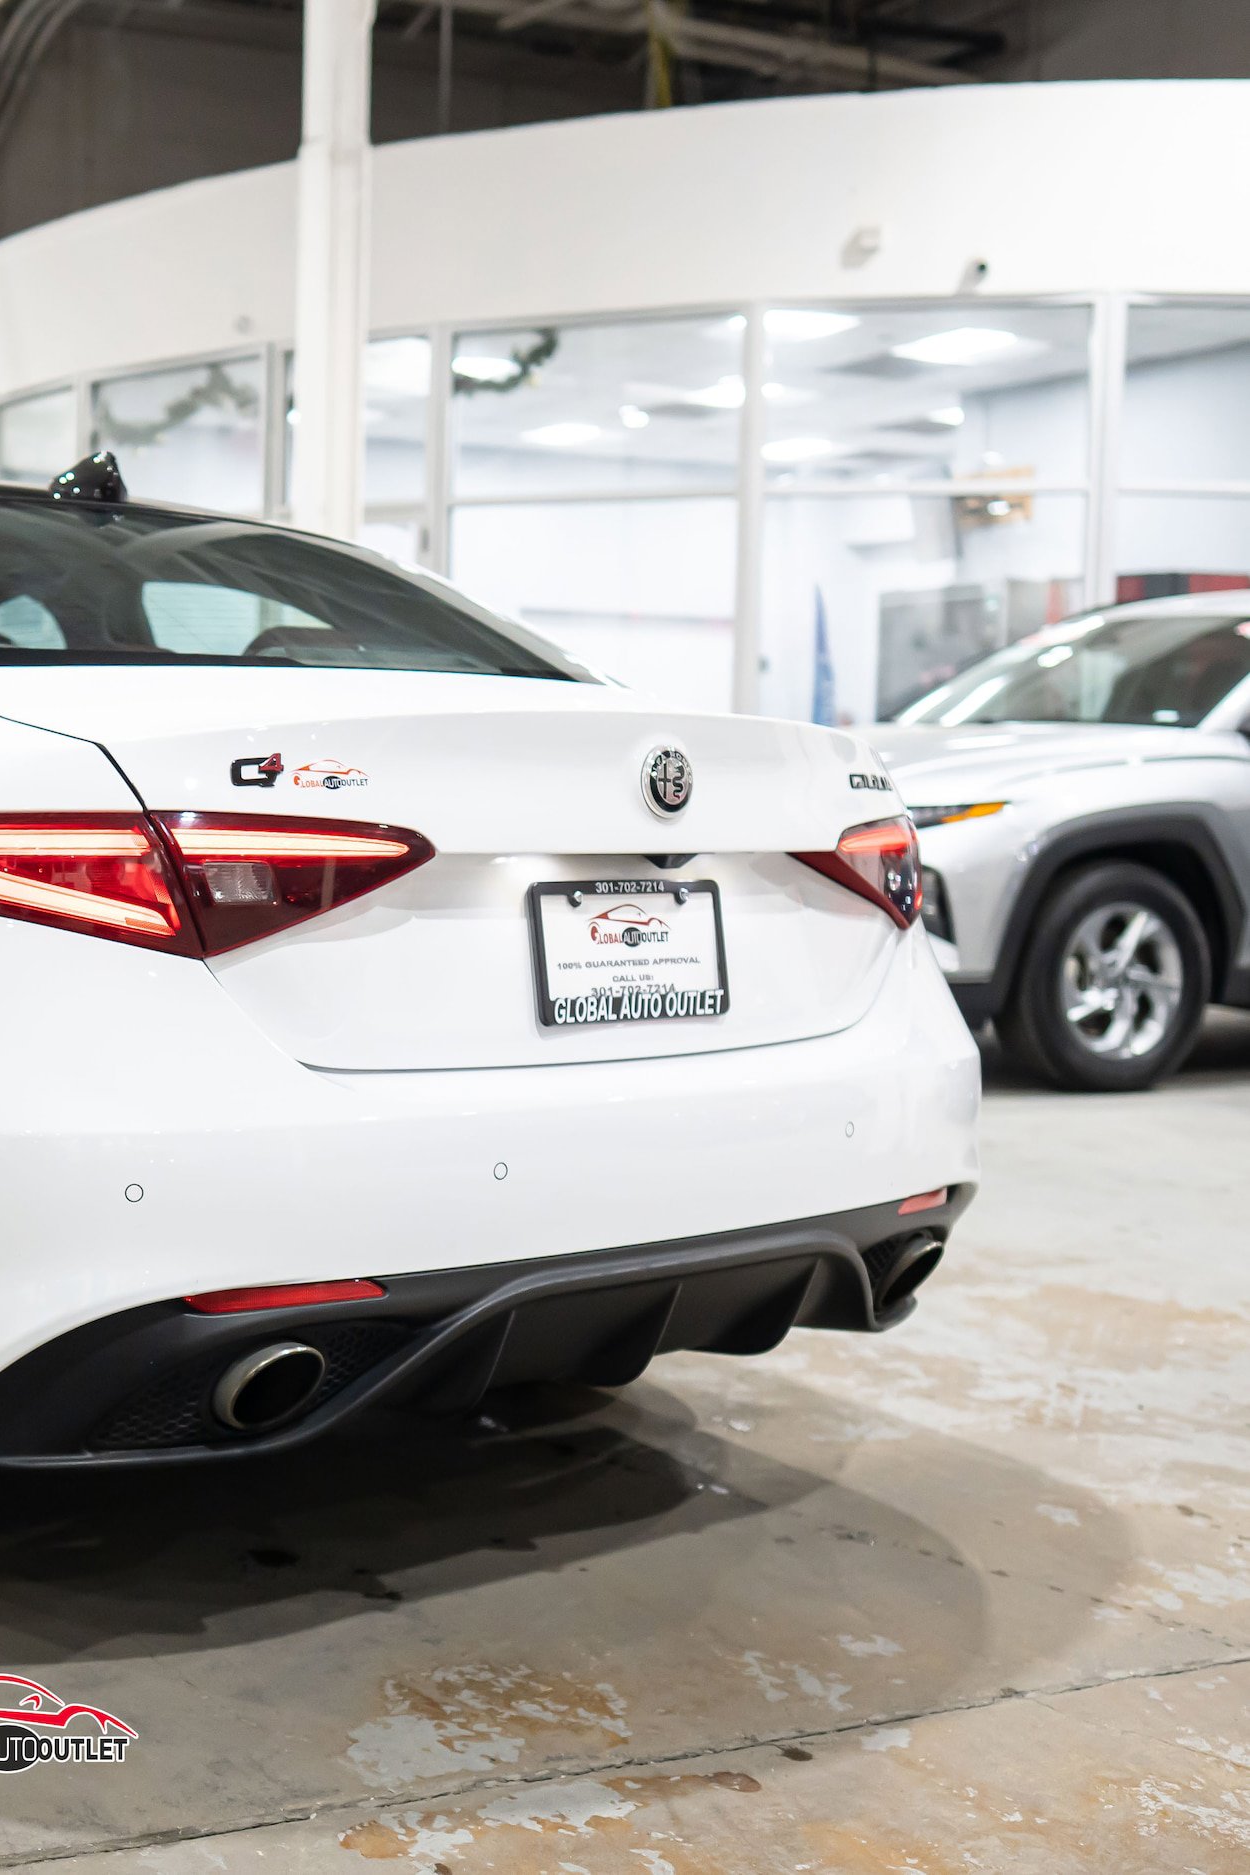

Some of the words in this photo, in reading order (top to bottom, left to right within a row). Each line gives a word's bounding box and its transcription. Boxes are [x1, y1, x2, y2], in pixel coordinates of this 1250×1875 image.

[230, 752, 284, 787] Q4
[595, 881, 664, 894] 301-702-7214
[557, 962, 582, 970] 100%
[585, 959, 650, 969] GUARANTEED
[652, 957, 701, 965] APPROVAL
[612, 974, 636, 982] CALL
[591, 983, 676, 998] 301-702-7214
[554, 996, 618, 1024] GLOBAL
[620, 992, 662, 1020] AUTO
[665, 989, 724, 1017] OUTLET
